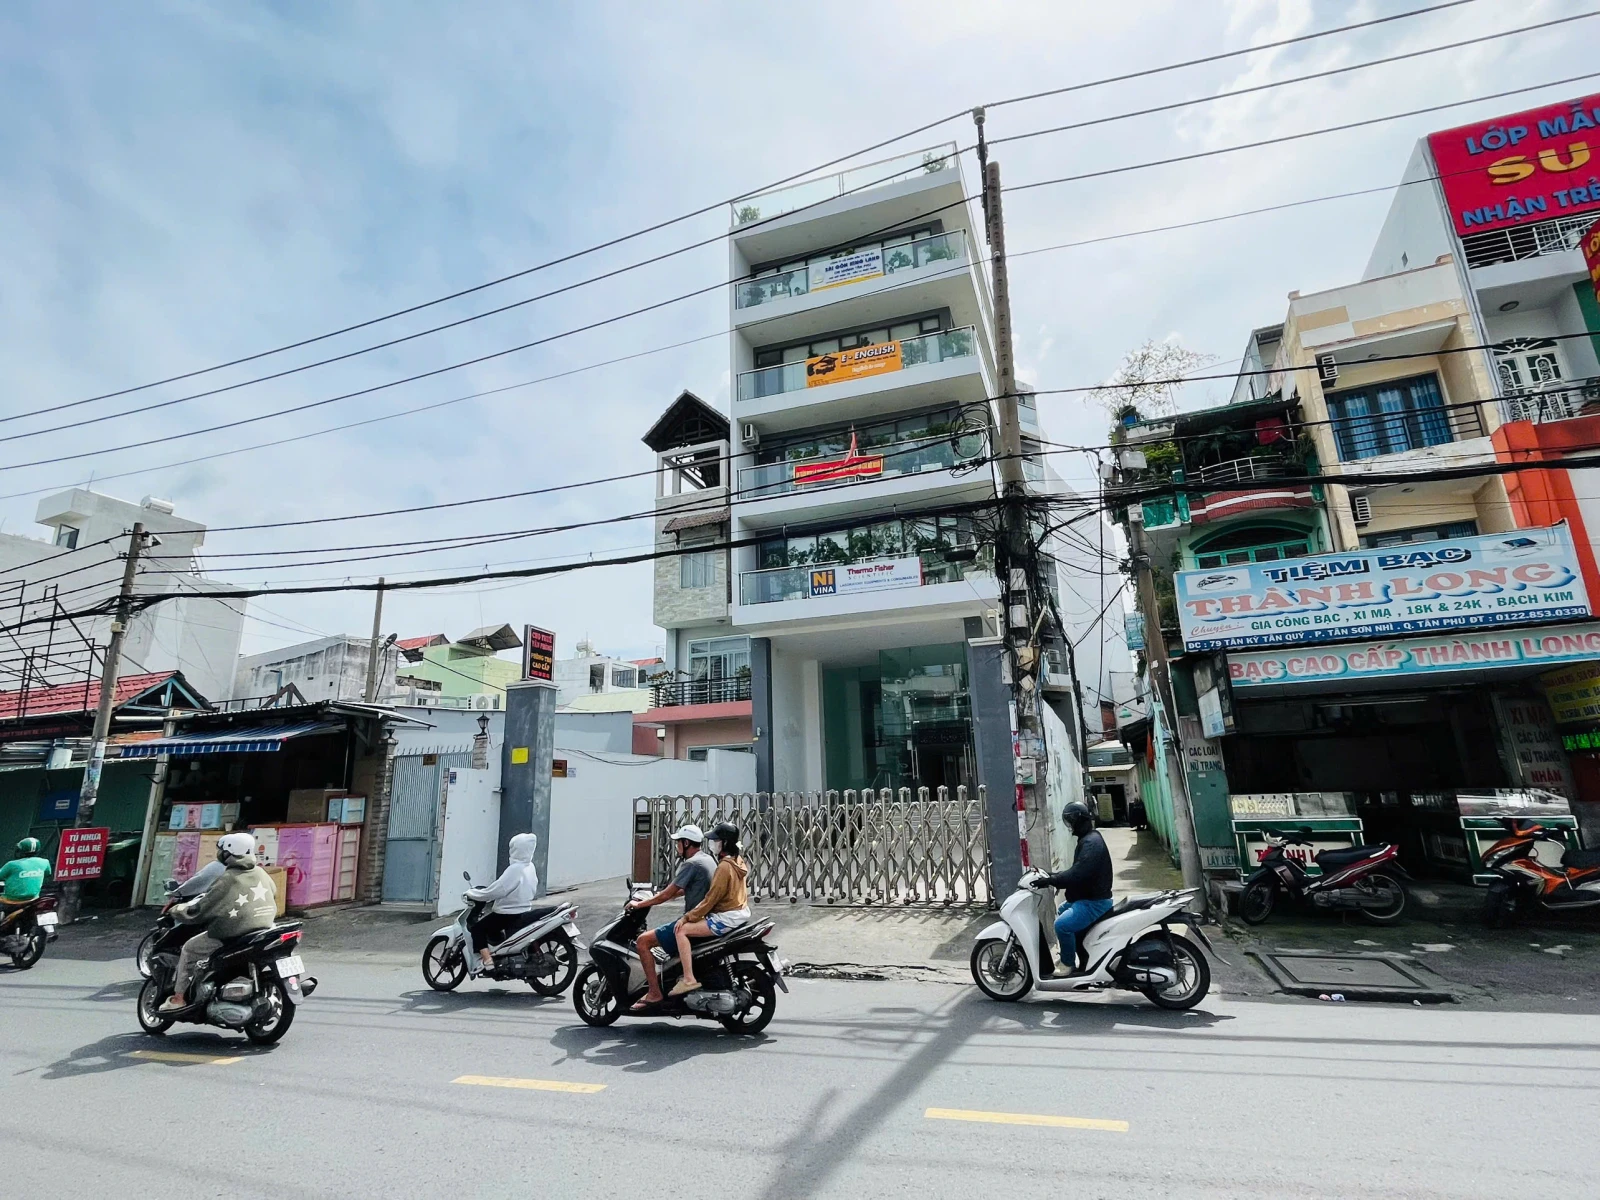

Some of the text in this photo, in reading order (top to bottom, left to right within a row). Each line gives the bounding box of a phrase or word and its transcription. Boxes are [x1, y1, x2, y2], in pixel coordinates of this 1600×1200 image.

[1465, 125, 1528, 155] LỚP
[1487, 141, 1591, 185] SU
[1462, 196, 1548, 227] NHẬN
[854, 344, 895, 360] ENGLISH
[813, 571, 833, 586] Ni
[847, 567, 873, 575] Thermo
[1263, 548, 1468, 582] TIỆM BẠC
[813, 585, 834, 595] VINA
[1185, 563, 1555, 616] THÀNH LONG
[1251, 620, 1271, 630] GIA
[1275, 613, 1310, 628] CÔNG
[1314, 613, 1341, 625] BẠC
[1353, 610, 1368, 620] XI
[1371, 608, 1392, 619] MẠ
[1407, 604, 1433, 615] 18K
[1438, 603, 1449, 612] &
[1454, 599, 1482, 611] 24K
[1497, 593, 1538, 608] BẠCH
[1544, 591, 1573, 602] KIM
[1224, 638, 1243, 646] TÂN
[1262, 634, 1283, 643] TÂN
[1327, 628, 1348, 636] TÂN
[1351, 625, 1372, 634] SƠN
[1375, 623, 1394, 631] NHÌ
[1417, 618, 1440, 627] TÂN
[1443, 615, 1465, 625] PHÚ
[1470, 615, 1484, 623] ĐT
[1496, 607, 1587, 621] 0122.853.0330
[532, 661, 541, 669] CAO
[1229, 632, 1600, 680] BẠC CAO CẤP THÀNH LONG
